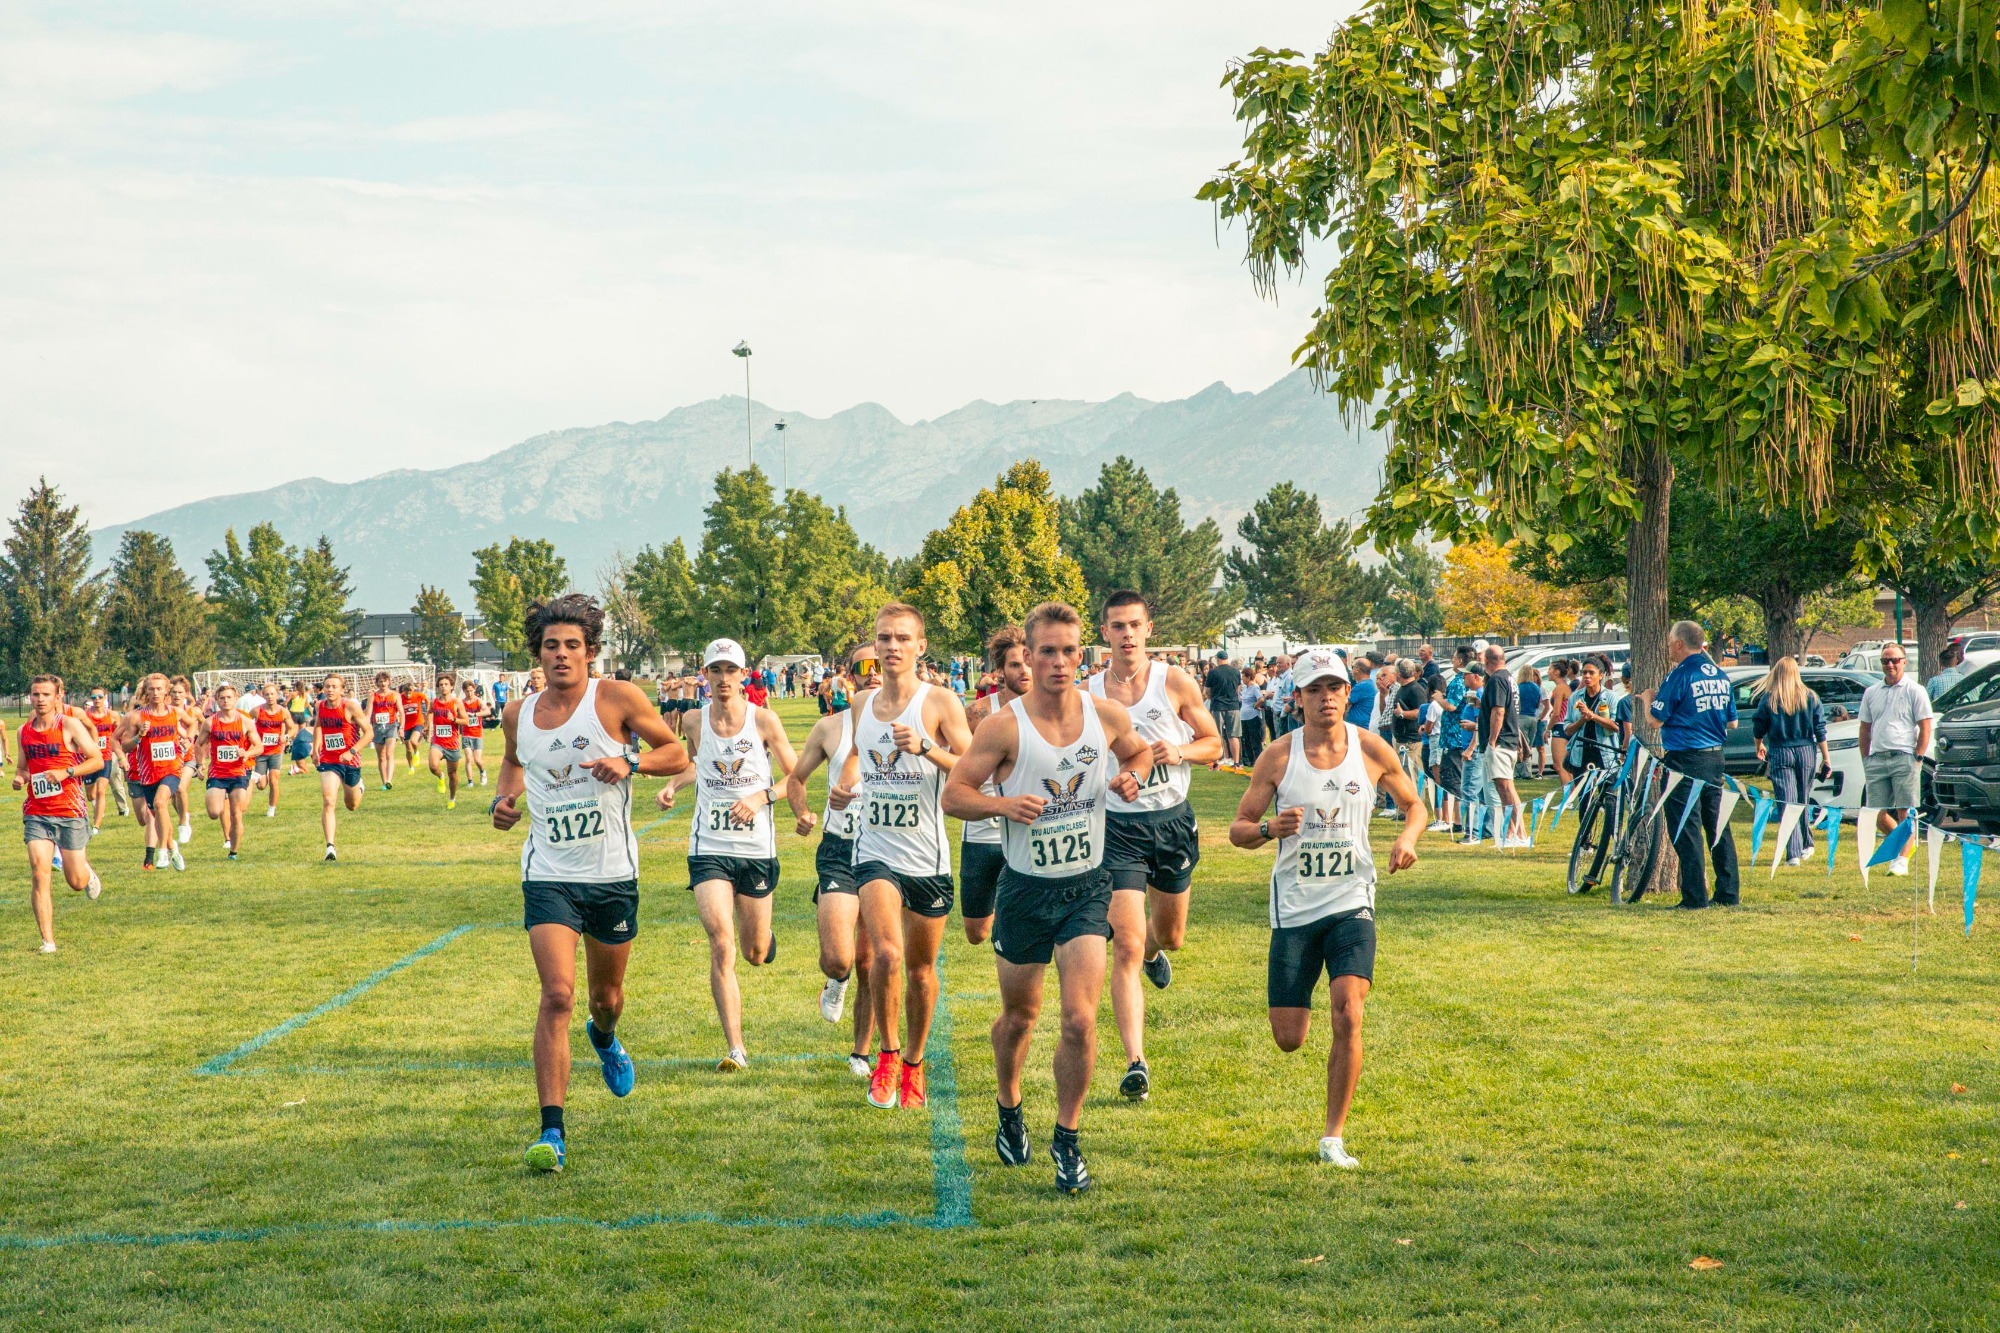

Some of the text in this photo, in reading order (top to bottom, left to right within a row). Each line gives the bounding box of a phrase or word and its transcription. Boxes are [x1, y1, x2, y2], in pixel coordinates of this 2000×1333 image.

[1691, 680, 1731, 697] EVENT
[1696, 696, 1730, 713] STAFF
[212, 730, 242, 741] SNOW
[325, 738, 345, 748] 3038
[152, 747, 175, 759] 3050
[218, 750, 239, 760] 3053
[1076, 750, 1098, 761] RMAC
[1056, 764, 1075, 772] adidas
[879, 792, 899, 800] AUTUMN
[899, 793, 919, 801] CLASSIC
[546, 799, 599, 815] BYU AUTUMN CLASSIC
[869, 801, 919, 828] 3123
[1040, 814, 1060, 823] CROSS
[547, 810, 605, 844] 3122
[1031, 820, 1087, 837] BYU AUTUMN CLASSIC
[1032, 831, 1091, 867] 3125
[1300, 841, 1312, 849] BYU
[1312, 841, 1334, 849] AUTUMN
[1299, 850, 1354, 878] 3121
